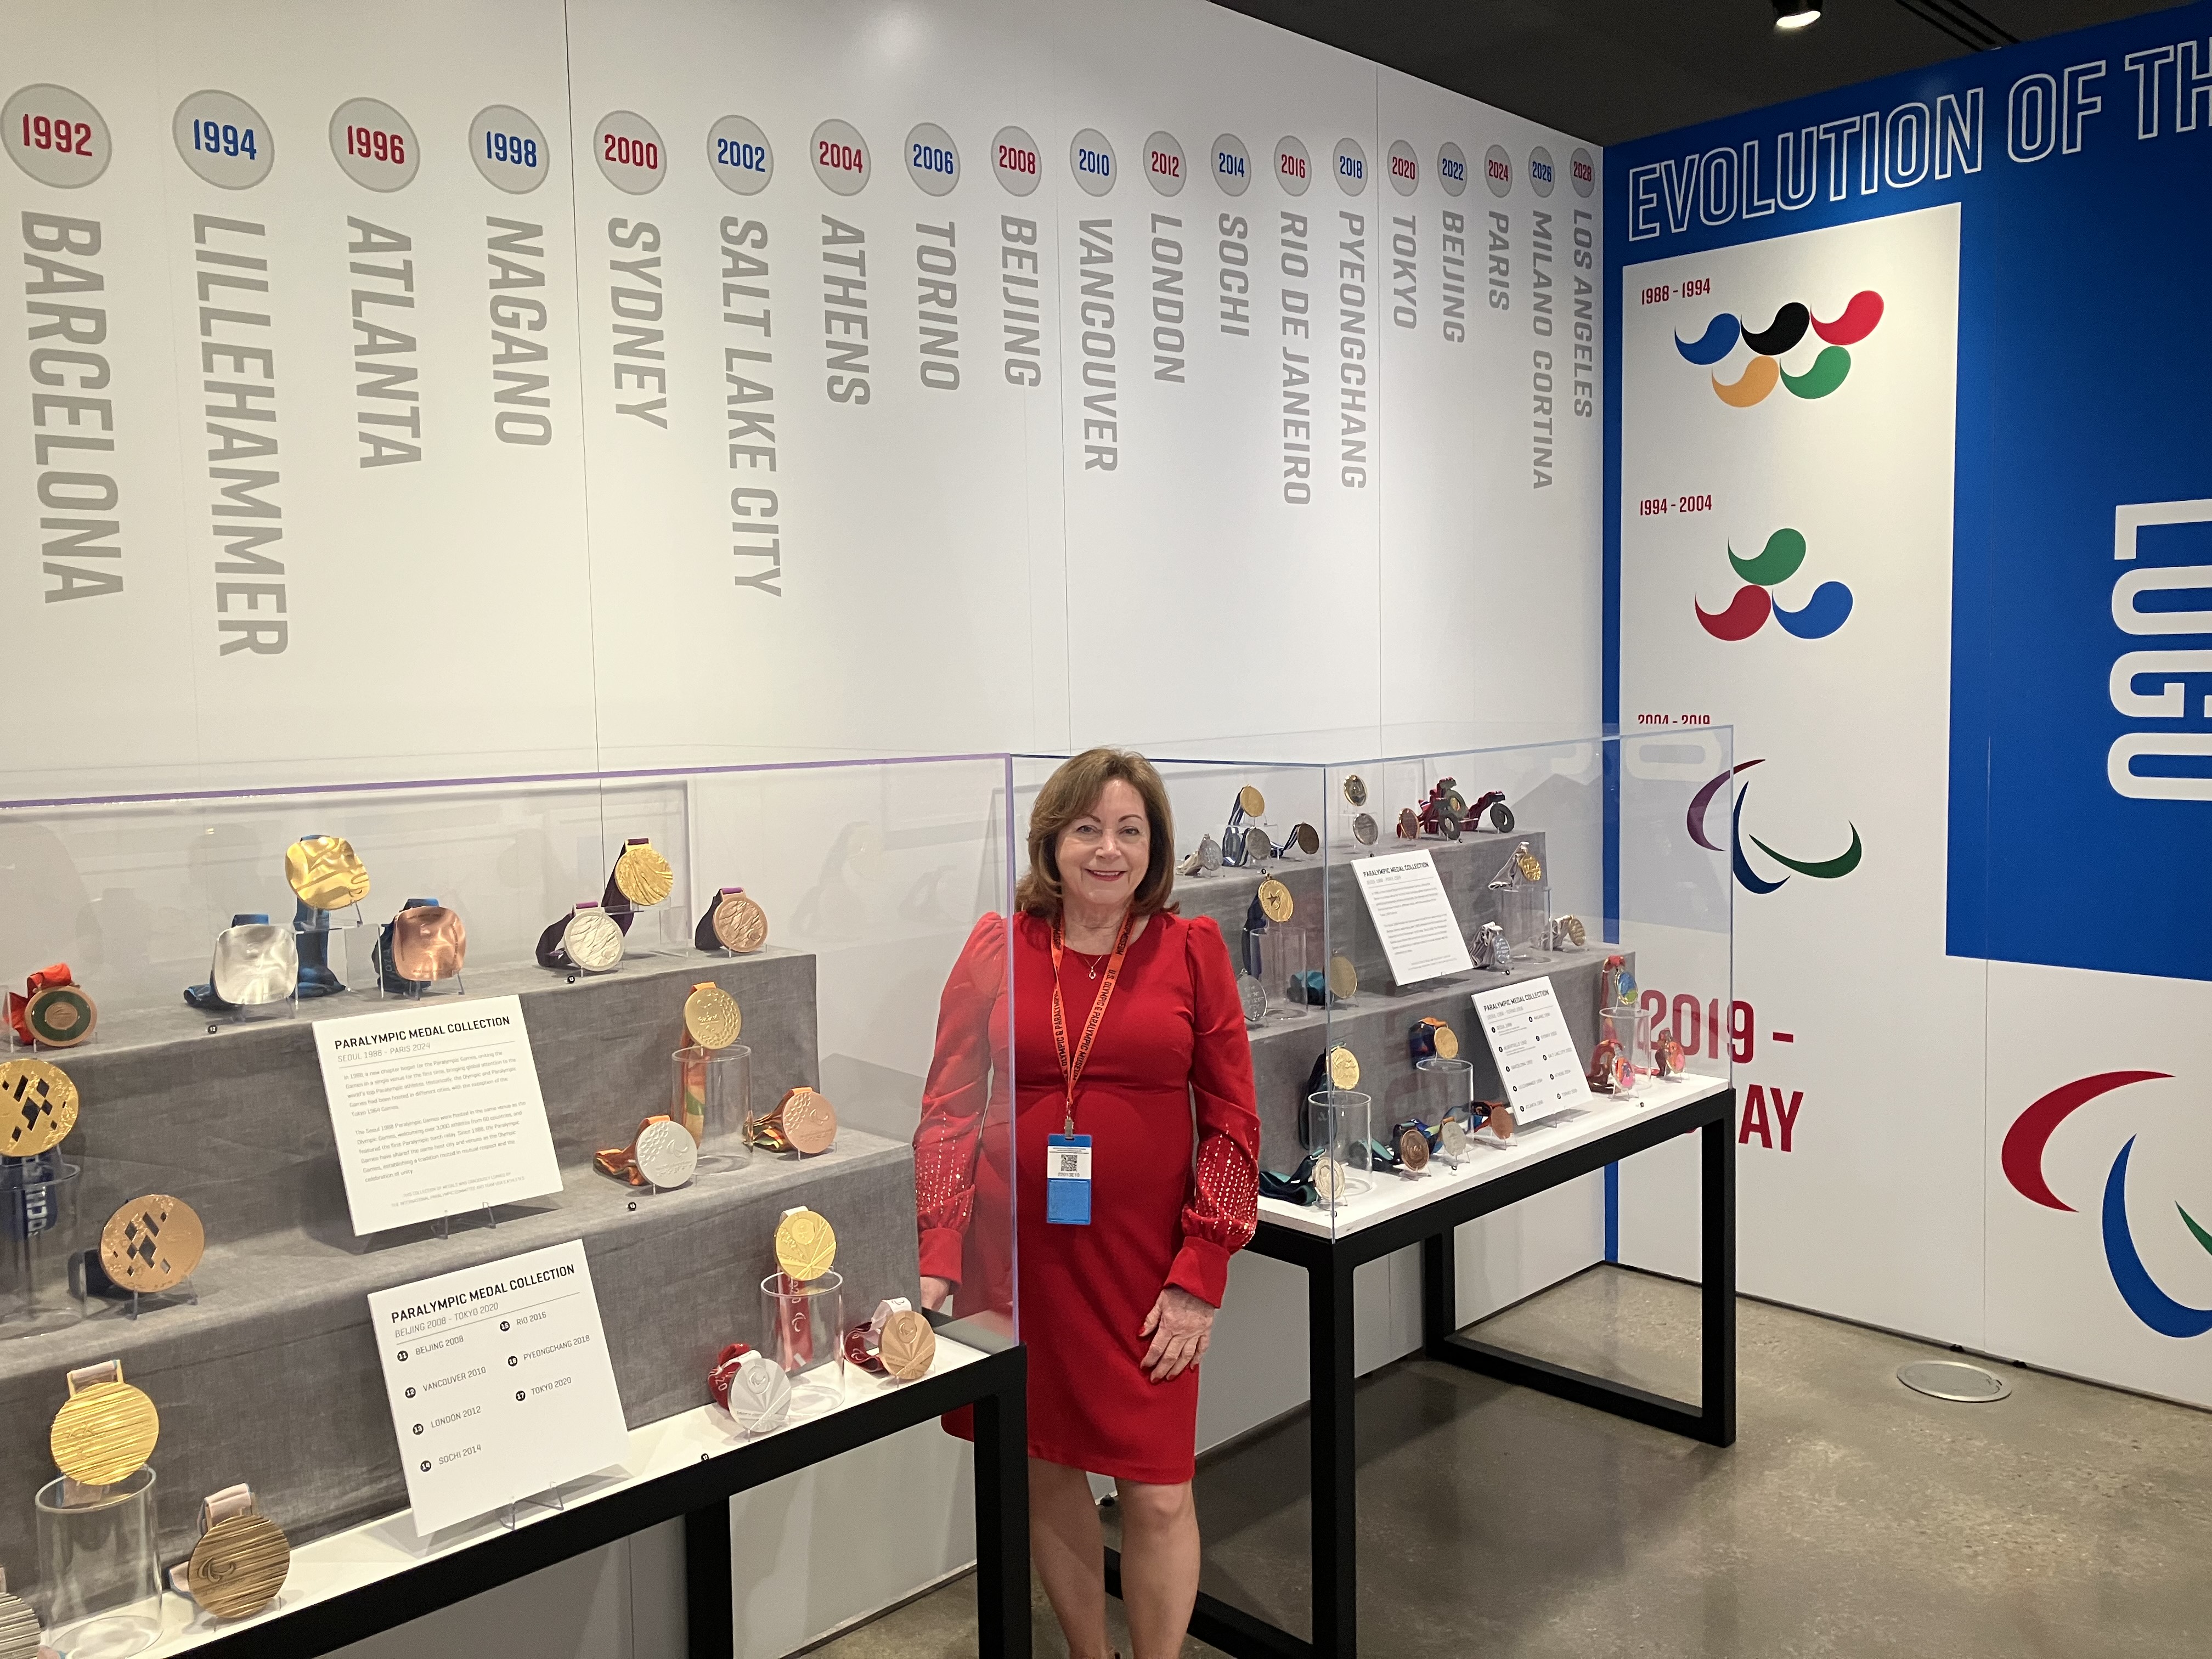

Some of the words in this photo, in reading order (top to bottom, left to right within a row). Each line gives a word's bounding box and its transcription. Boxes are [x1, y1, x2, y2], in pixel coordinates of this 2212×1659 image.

[23, 114, 93, 156] 1992
[194, 119, 257, 160] 1994
[347, 126, 405, 165] 1996
[487, 132, 538, 167] 1998
[605, 133, 658, 170] 2000
[1629, 87, 1983, 241] EVOLUTION
[2008, 60, 2106, 162] OF
[718, 138, 765, 172] 2002
[819, 141, 863, 172] 2004
[913, 144, 954, 175] 2006
[999, 145, 1036, 174] 2008
[1080, 149, 1110, 176] 2010
[1152, 151, 1179, 177] 2012
[1220, 153, 1245, 175] 2014
[1282, 155, 1306, 178] 2016
[1341, 156, 1362, 178] 2018
[1392, 157, 1415, 180] 2020
[1442, 158, 1464, 181] 2022
[1488, 159, 1509, 182] 2024
[1532, 161, 1551, 183] 2026
[1573, 164, 1592, 182] 2028
[1280, 211, 1308, 278] RIO
[1573, 209, 1592, 270] LOS
[720, 216, 771, 337] SALT
[1218, 213, 1250, 337] SOCHI
[1392, 215, 1417, 329] TOKYO
[1442, 210, 1465, 343] BEIJING
[1488, 210, 1510, 311] PARIS
[1533, 210, 1553, 337] MILANO
[821, 214, 871, 405] ATHENS
[916, 221, 960, 391] TORINO
[1001, 215, 1041, 387] BEIJING
[1150, 213, 1185, 383] LONDON
[1642, 285, 1669, 304] 1988
[1682, 278, 1710, 297] 1994
[486, 216, 553, 445] NAGANO
[607, 217, 668, 430] SYDNEY
[1281, 288, 1309, 340] DE
[347, 215, 422, 469] ATLANTA
[1079, 219, 1118, 471] VANCOUVER
[1339, 210, 1367, 488] PYEONGCHANG
[1573, 275, 1592, 418] ANGELES
[21, 211, 123, 603] BARCELONA
[725, 347, 776, 473] LAKE
[1282, 347, 1311, 505] JANEIRO
[1533, 349, 1553, 489] CORTINA
[193, 213, 288, 656] LILLEHAMMER
[1640, 498, 1668, 516] 1994
[1679, 494, 1712, 513] 2004
[731, 487, 782, 597] CITY
[2108, 499, 2212, 801] LOGO
[1363, 867, 1391, 877] PARALYMPIC
[1404, 862, 1429, 871] COLLECTION
[1097, 982, 1111, 1006] OLYMPIC
[1483, 999, 1511, 1012] PARALYMPIC
[1510, 996, 1525, 1005] MEDAL
[1524, 989, 1549, 1001] COLLECTION
[334, 1031, 407, 1049] PARALYMPIC
[408, 1025, 445, 1039] MEDAL
[447, 1016, 510, 1033] COLLECTION
[1081, 1012, 1100, 1054] PARALYMPIC
[1638, 990, 1754, 1063] 2019
[337, 1053, 362, 1063] SEOUL
[364, 1048, 382, 1059] 1988
[390, 1044, 411, 1054] PARIS
[412, 1042, 430, 1051] 2024
[1057, 1036, 1067, 1066] OLYMPIC
[391, 1293, 467, 1323] PARALYMPIC
[469, 1283, 508, 1302] MEDAL
[509, 1263, 574, 1290] COLLECTION
[394, 1322, 426, 1339] BEIJING
[426, 1316, 447, 1329] 2008
[454, 1307, 478, 1321] TOKYO
[479, 1301, 499, 1314] 2020
[515, 1316, 528, 1326] RIO
[528, 1311, 547, 1323] 2016
[414, 1341, 444, 1356] BEIJING
[444, 1335, 464, 1347] 2008
[523, 1340, 572, 1361] PYEONGCHANG
[573, 1334, 590, 1345] 2018
[421, 1372, 466, 1392] VANCOUVER
[467, 1366, 486, 1378] 2010
[530, 1382, 554, 1396] TOKYO
[554, 1376, 572, 1389] 2020
[430, 1412, 461, 1429] LONDON
[462, 1406, 481, 1418] 2012
[438, 1451, 461, 1466] SOCHI
[462, 1443, 482, 1458] 2014
